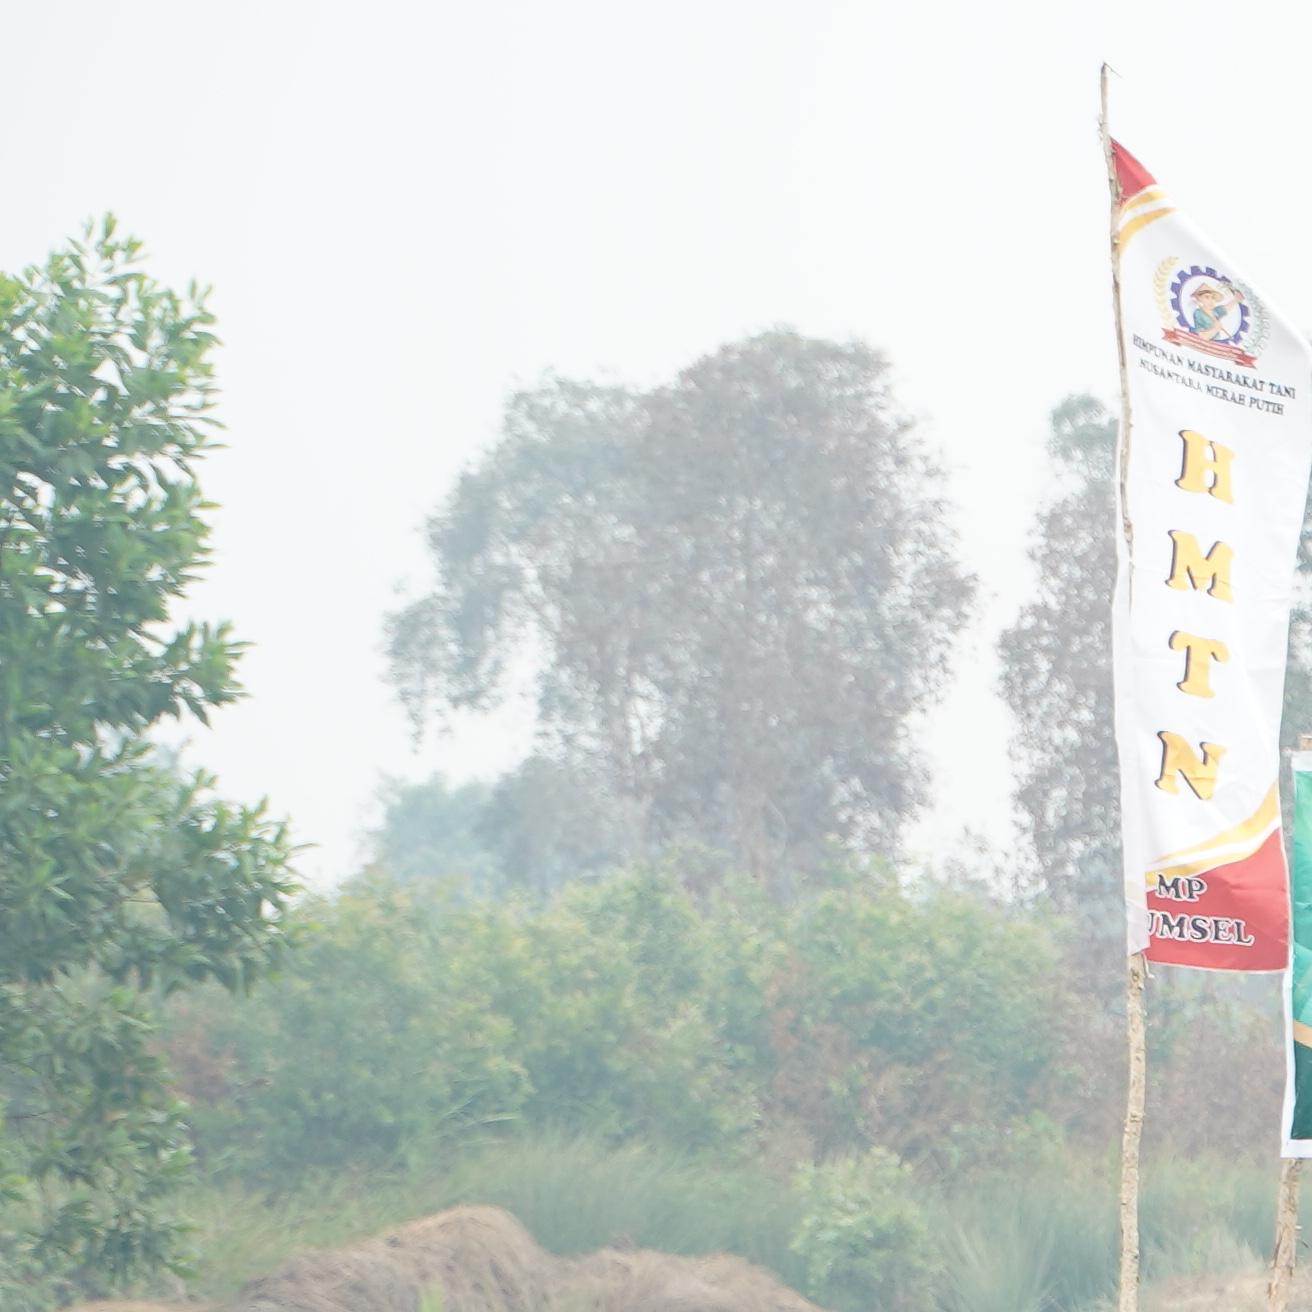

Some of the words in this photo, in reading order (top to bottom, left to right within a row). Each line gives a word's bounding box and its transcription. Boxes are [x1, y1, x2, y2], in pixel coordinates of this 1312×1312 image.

[1132, 334, 1183, 366] HIMPUNAN
[1188, 360, 1265, 392] MASYARAKAT
[1269, 382, 1296, 399] TANI
[1139, 359, 1202, 391] NUSANTARA
[1206, 385, 1245, 406] MERAH
[1249, 396, 1284, 415] PUTIH
[1156, 429, 1235, 800] HMTN
[1156, 873, 1206, 900] MP
